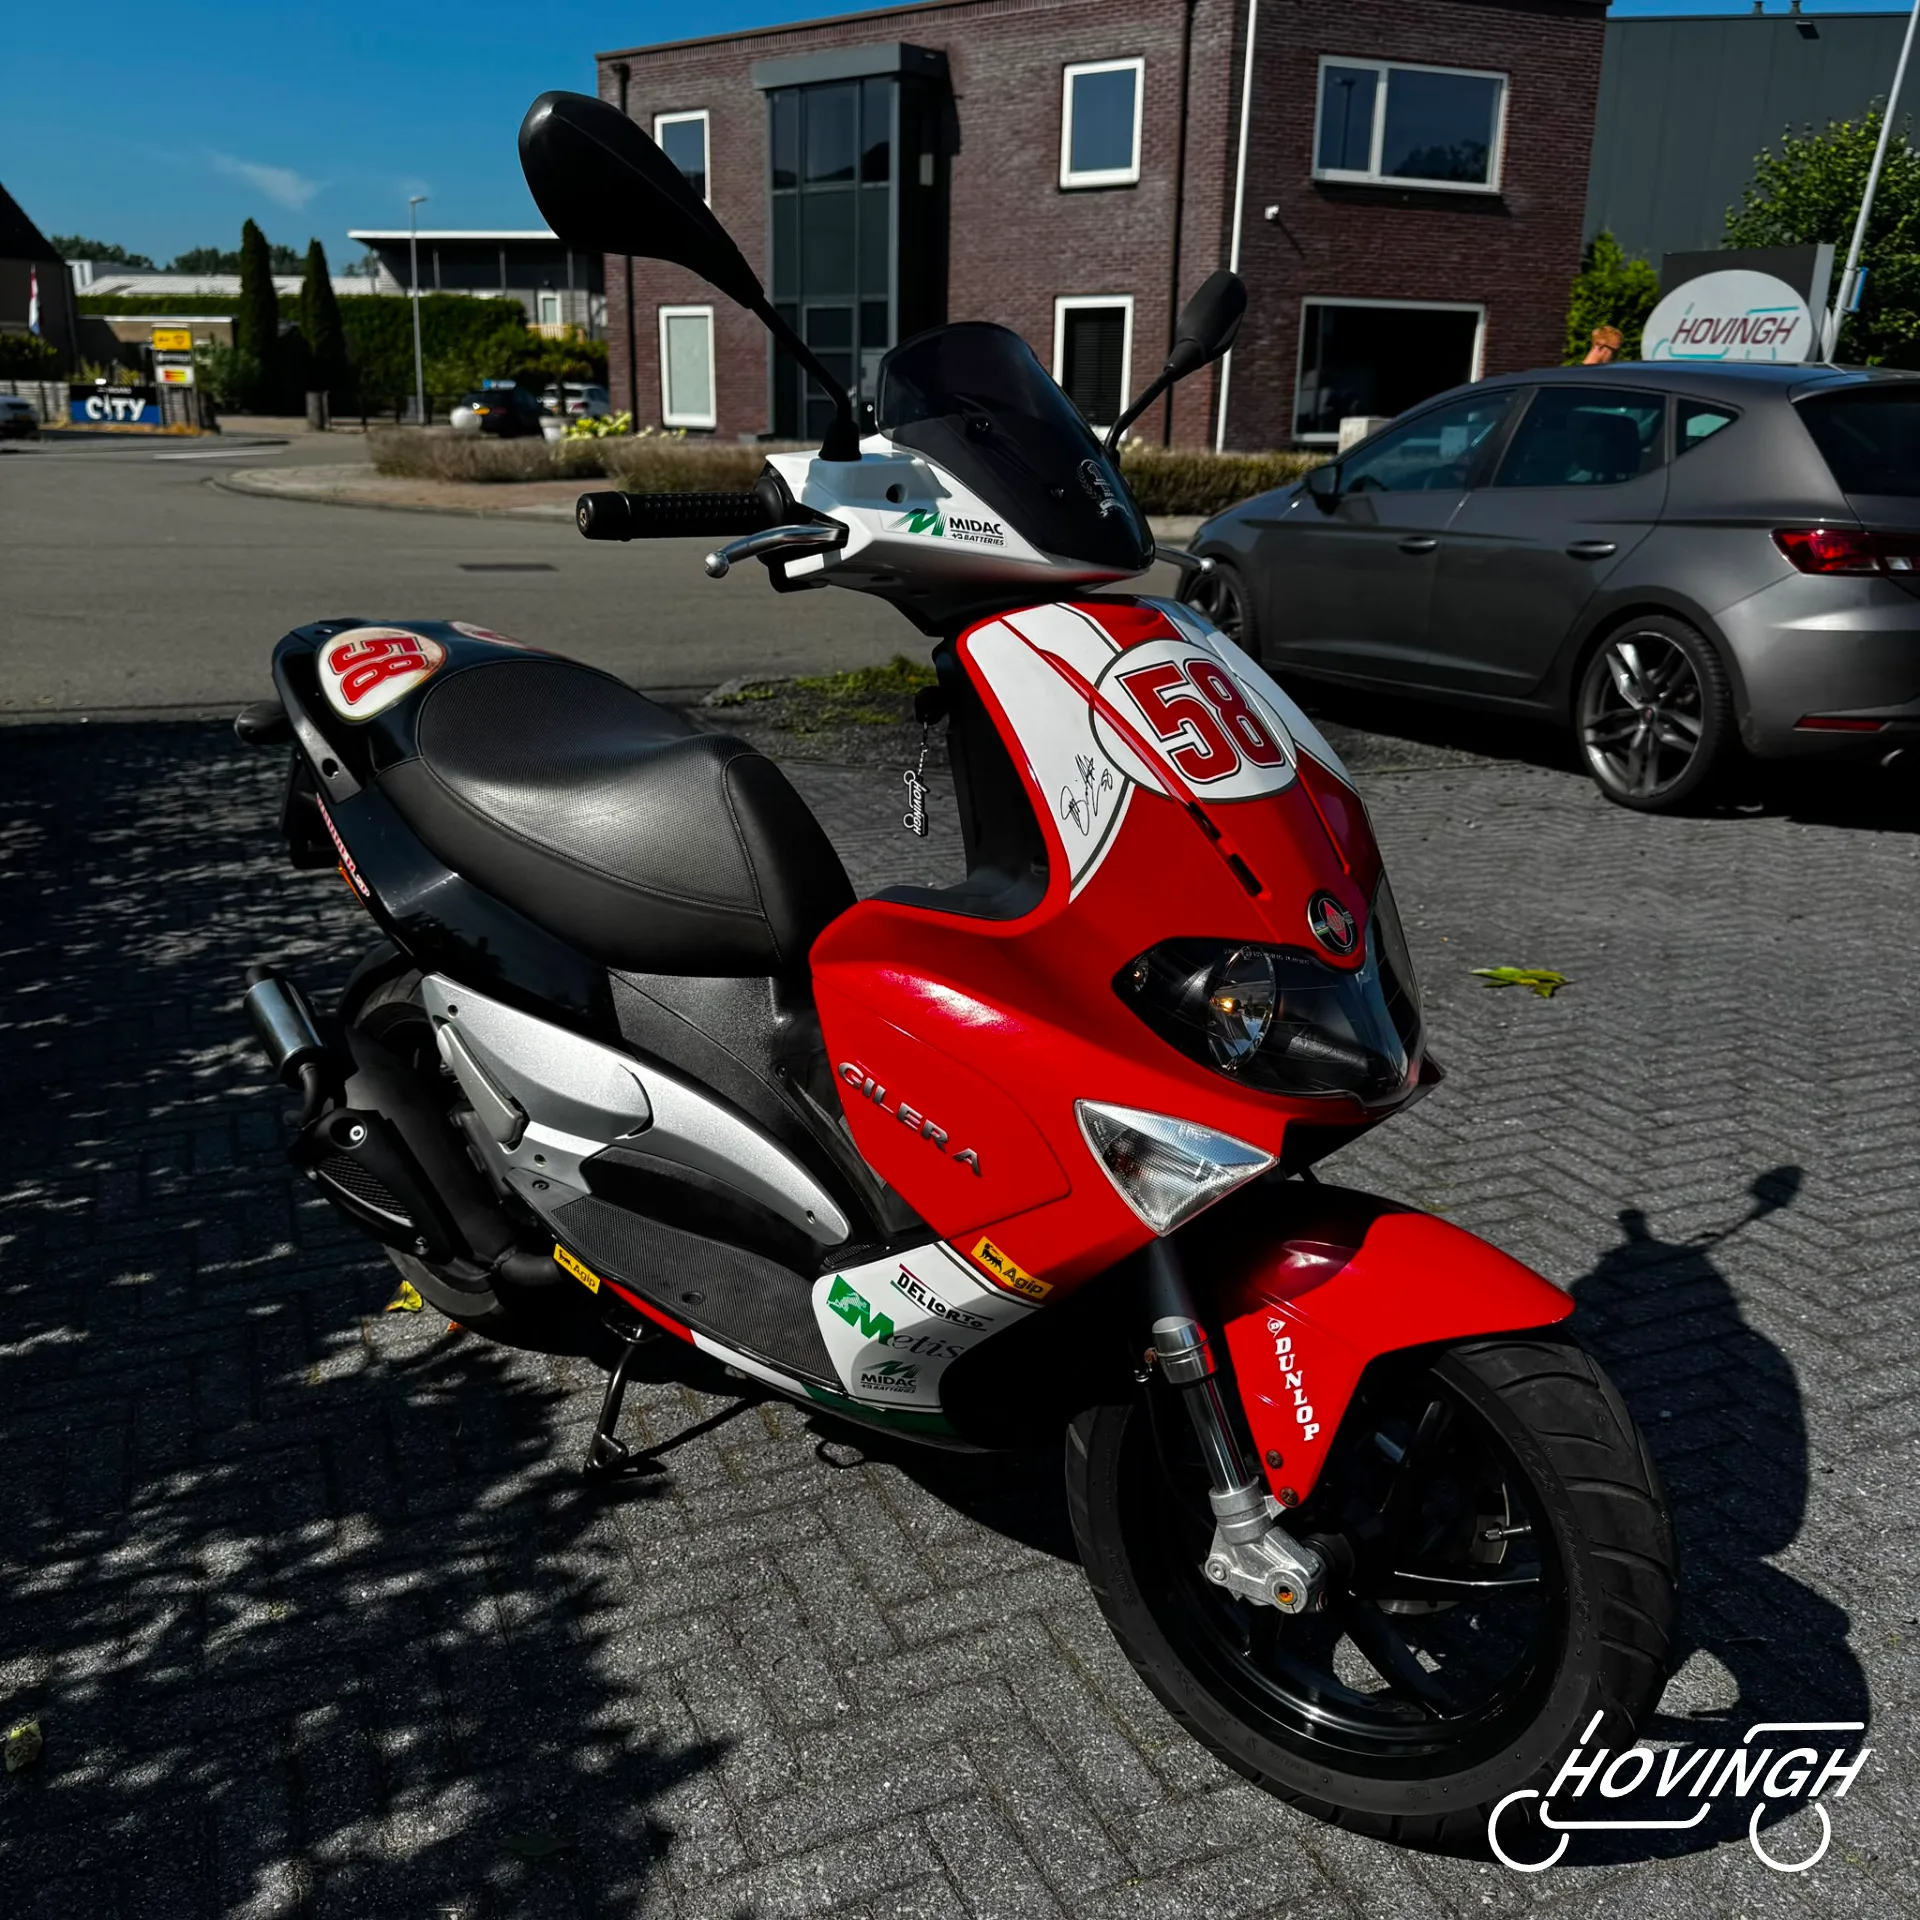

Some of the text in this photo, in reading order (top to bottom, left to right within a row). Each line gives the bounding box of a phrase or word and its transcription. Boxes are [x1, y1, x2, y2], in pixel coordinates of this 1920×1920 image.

[1670, 316, 1800, 345] HOVINGH
[949, 517, 1004, 535] MIDAC
[964, 535, 1004, 546] BATTERIES
[327, 636, 430, 705] 58
[1114, 658, 1286, 785] 58
[912, 780, 922, 836] HOVINGH
[838, 1061, 982, 1177] GILERA
[573, 1265, 596, 1288] Agip
[1002, 1267, 1044, 1295] Agip
[861, 1373, 917, 1387] MIDAC
[1275, 1337, 1320, 1442] DUNLOP
